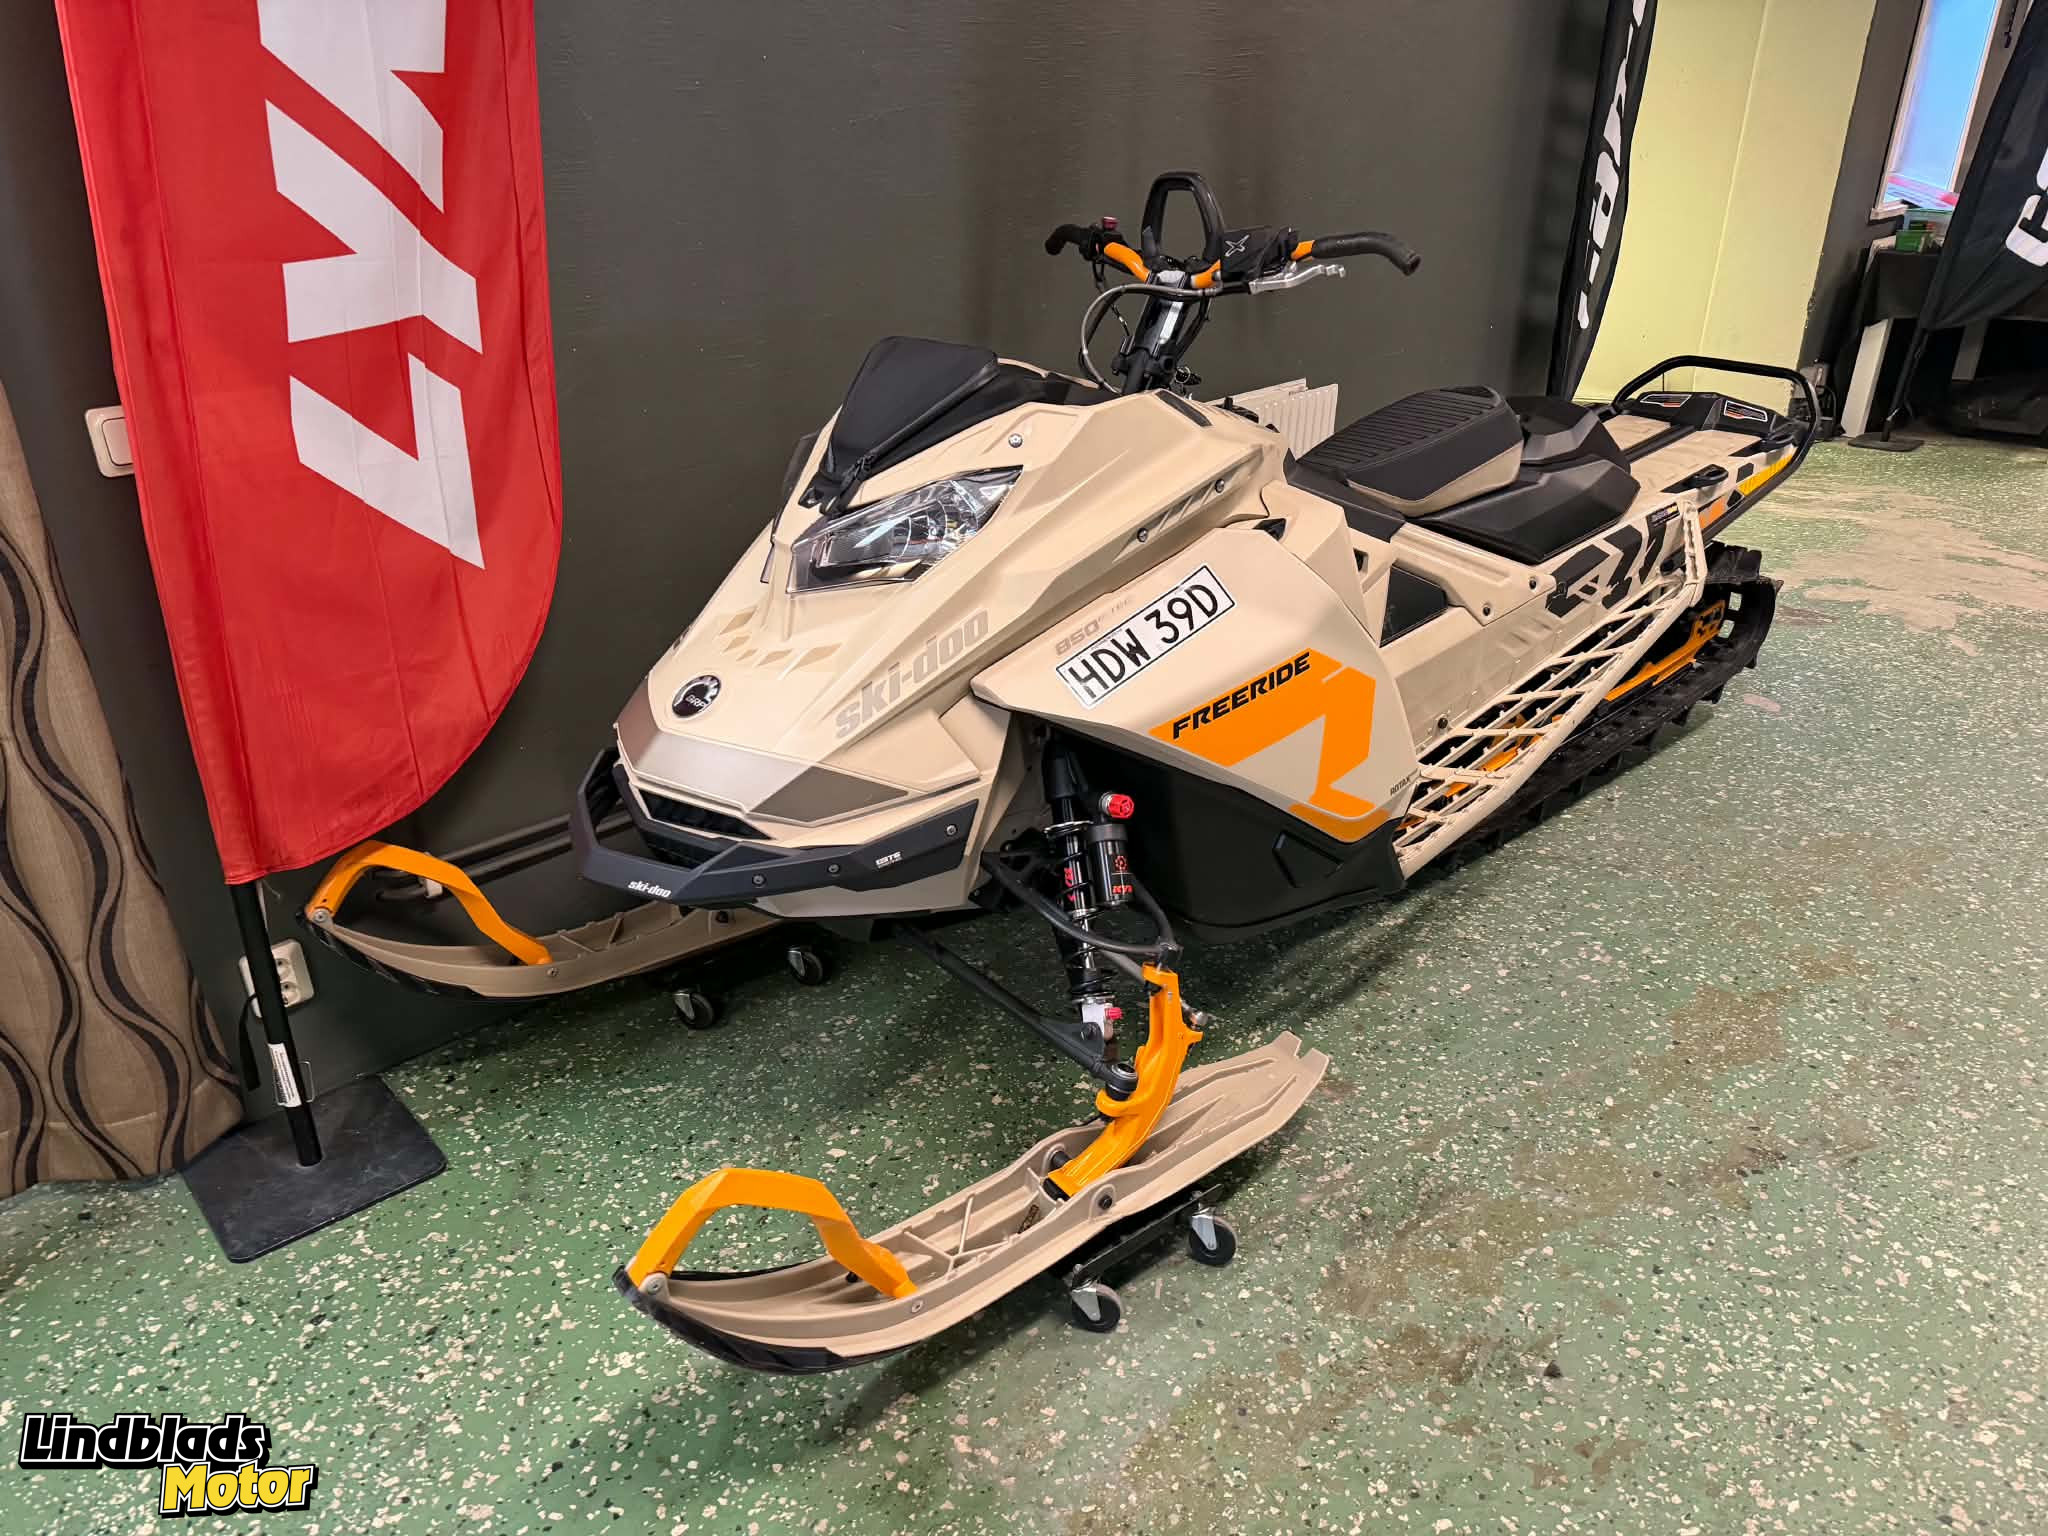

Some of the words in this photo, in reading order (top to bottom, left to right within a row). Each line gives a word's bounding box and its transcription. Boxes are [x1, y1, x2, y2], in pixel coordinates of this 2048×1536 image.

[1056, 621, 1099, 656] 850
[1068, 628, 1151, 698] HDW
[1144, 585, 1218, 644] 39D
[1173, 651, 1310, 740] FREERIDE
